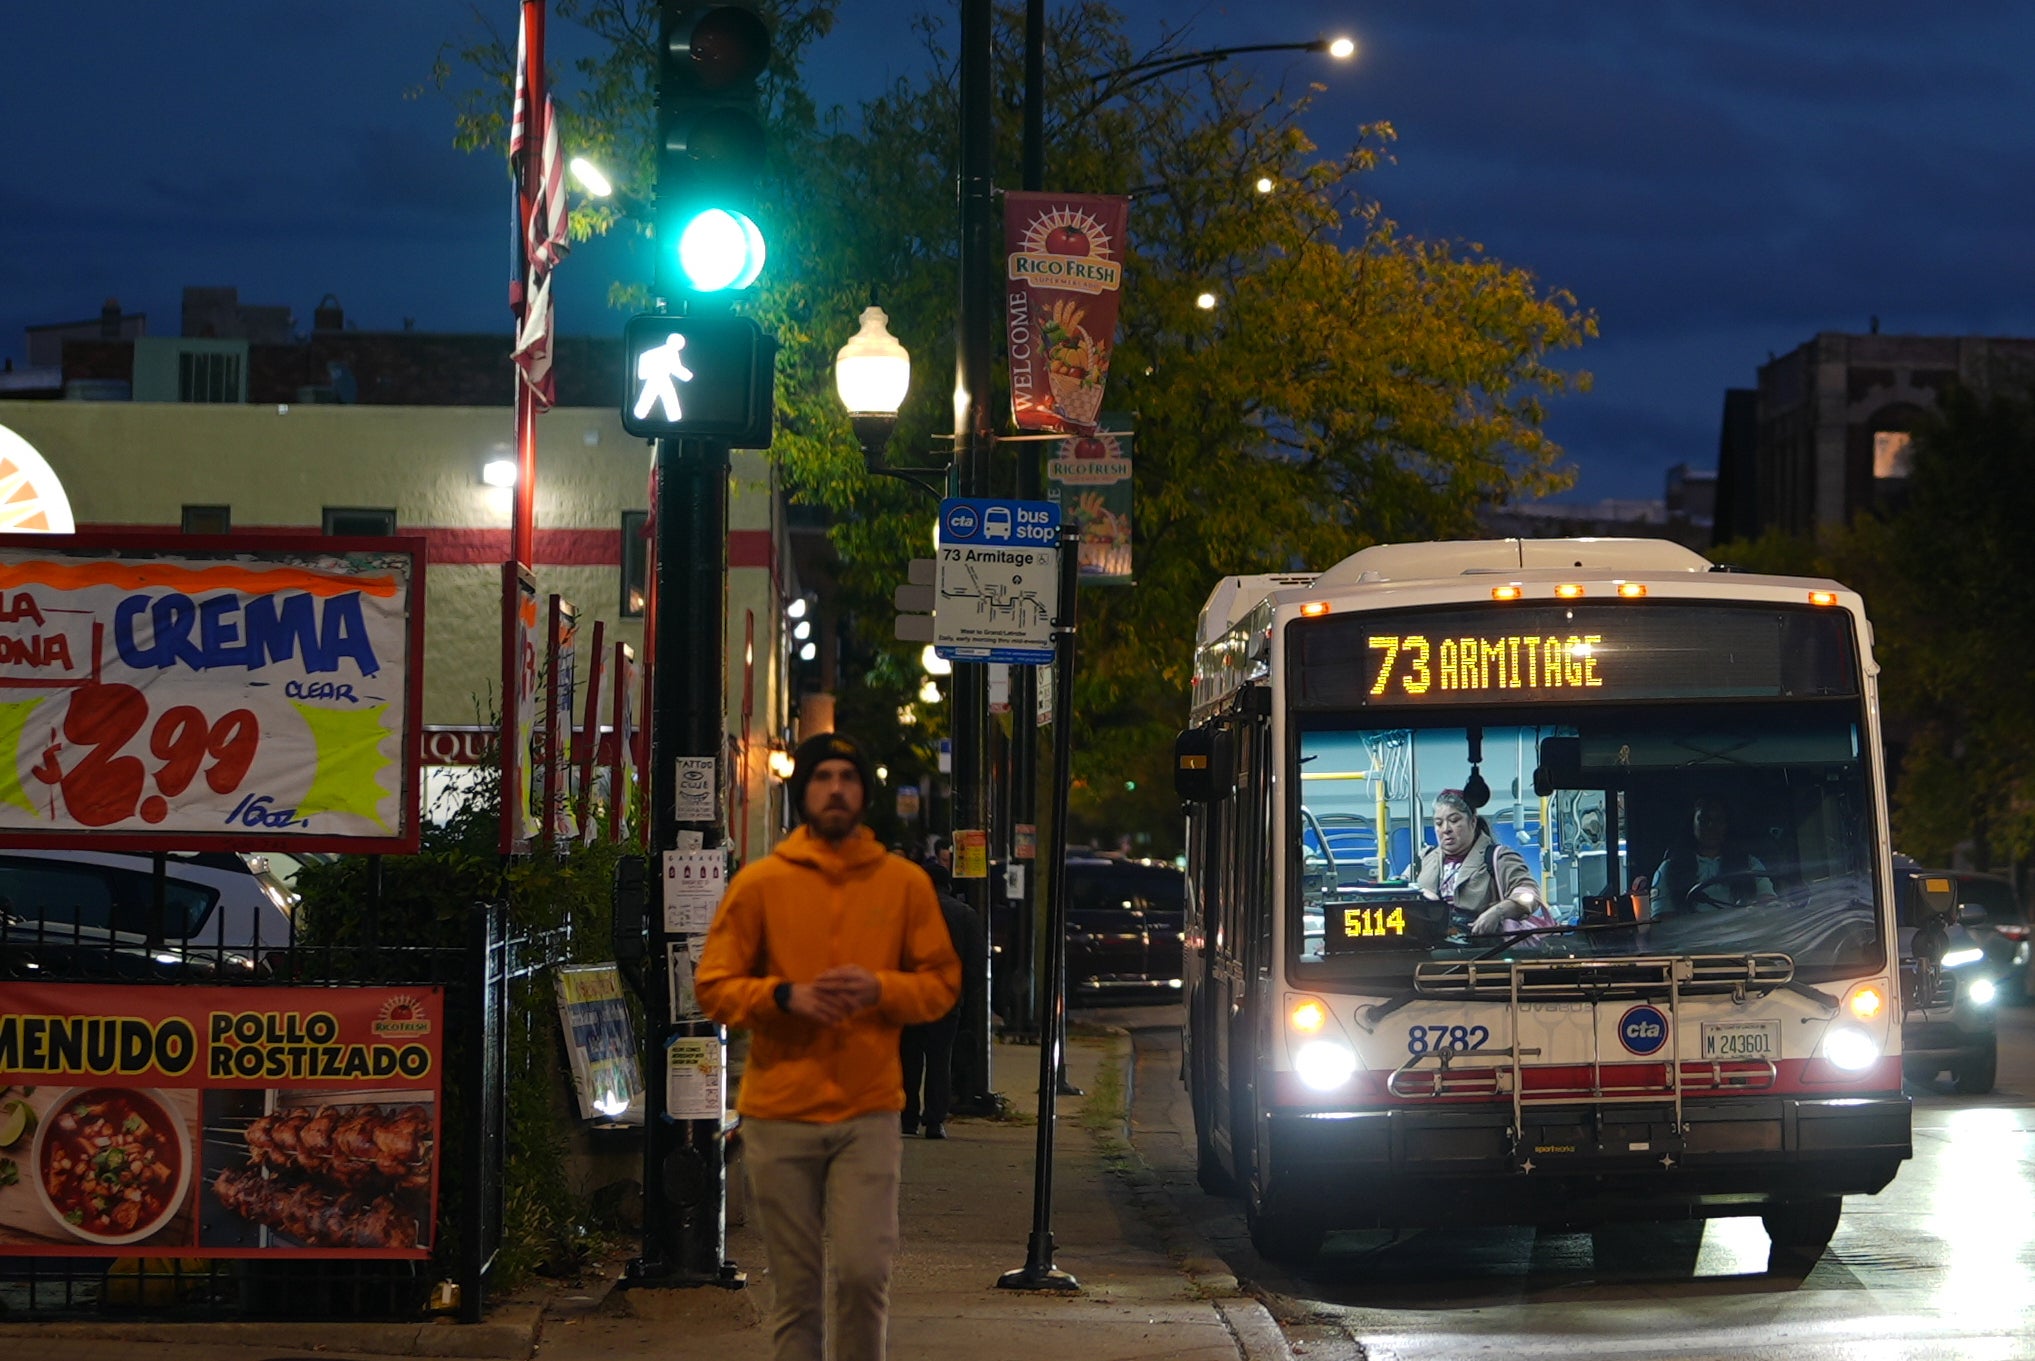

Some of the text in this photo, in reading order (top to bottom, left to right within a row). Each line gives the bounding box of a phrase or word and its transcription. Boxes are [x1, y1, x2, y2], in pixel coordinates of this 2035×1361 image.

[1016, 257, 1115, 283] RICO FRESH
[1010, 291, 1033, 412] WELCOME
[1054, 463, 1127, 475] RICO FRESH
[951, 515, 974, 528] cta
[1017, 507, 1049, 523] bus
[1016, 525, 1055, 543] stop
[943, 549, 1034, 567] 73 Armitage
[115, 591, 380, 678] CREMA
[1368, 636, 1603, 695] 73 ARMITAGE
[285, 680, 359, 703] CLEAR
[31, 683, 260, 828] $2.99
[1344, 908, 1406, 938] 5114
[209, 1012, 338, 1044] POLLO
[1408, 1025, 1489, 1055] 8782
[1626, 1020, 1660, 1038] cta
[0, 1015, 196, 1075] MENUDO
[1720, 1034, 1771, 1054] 243601
[208, 1043, 431, 1079] ROSTIZADO
